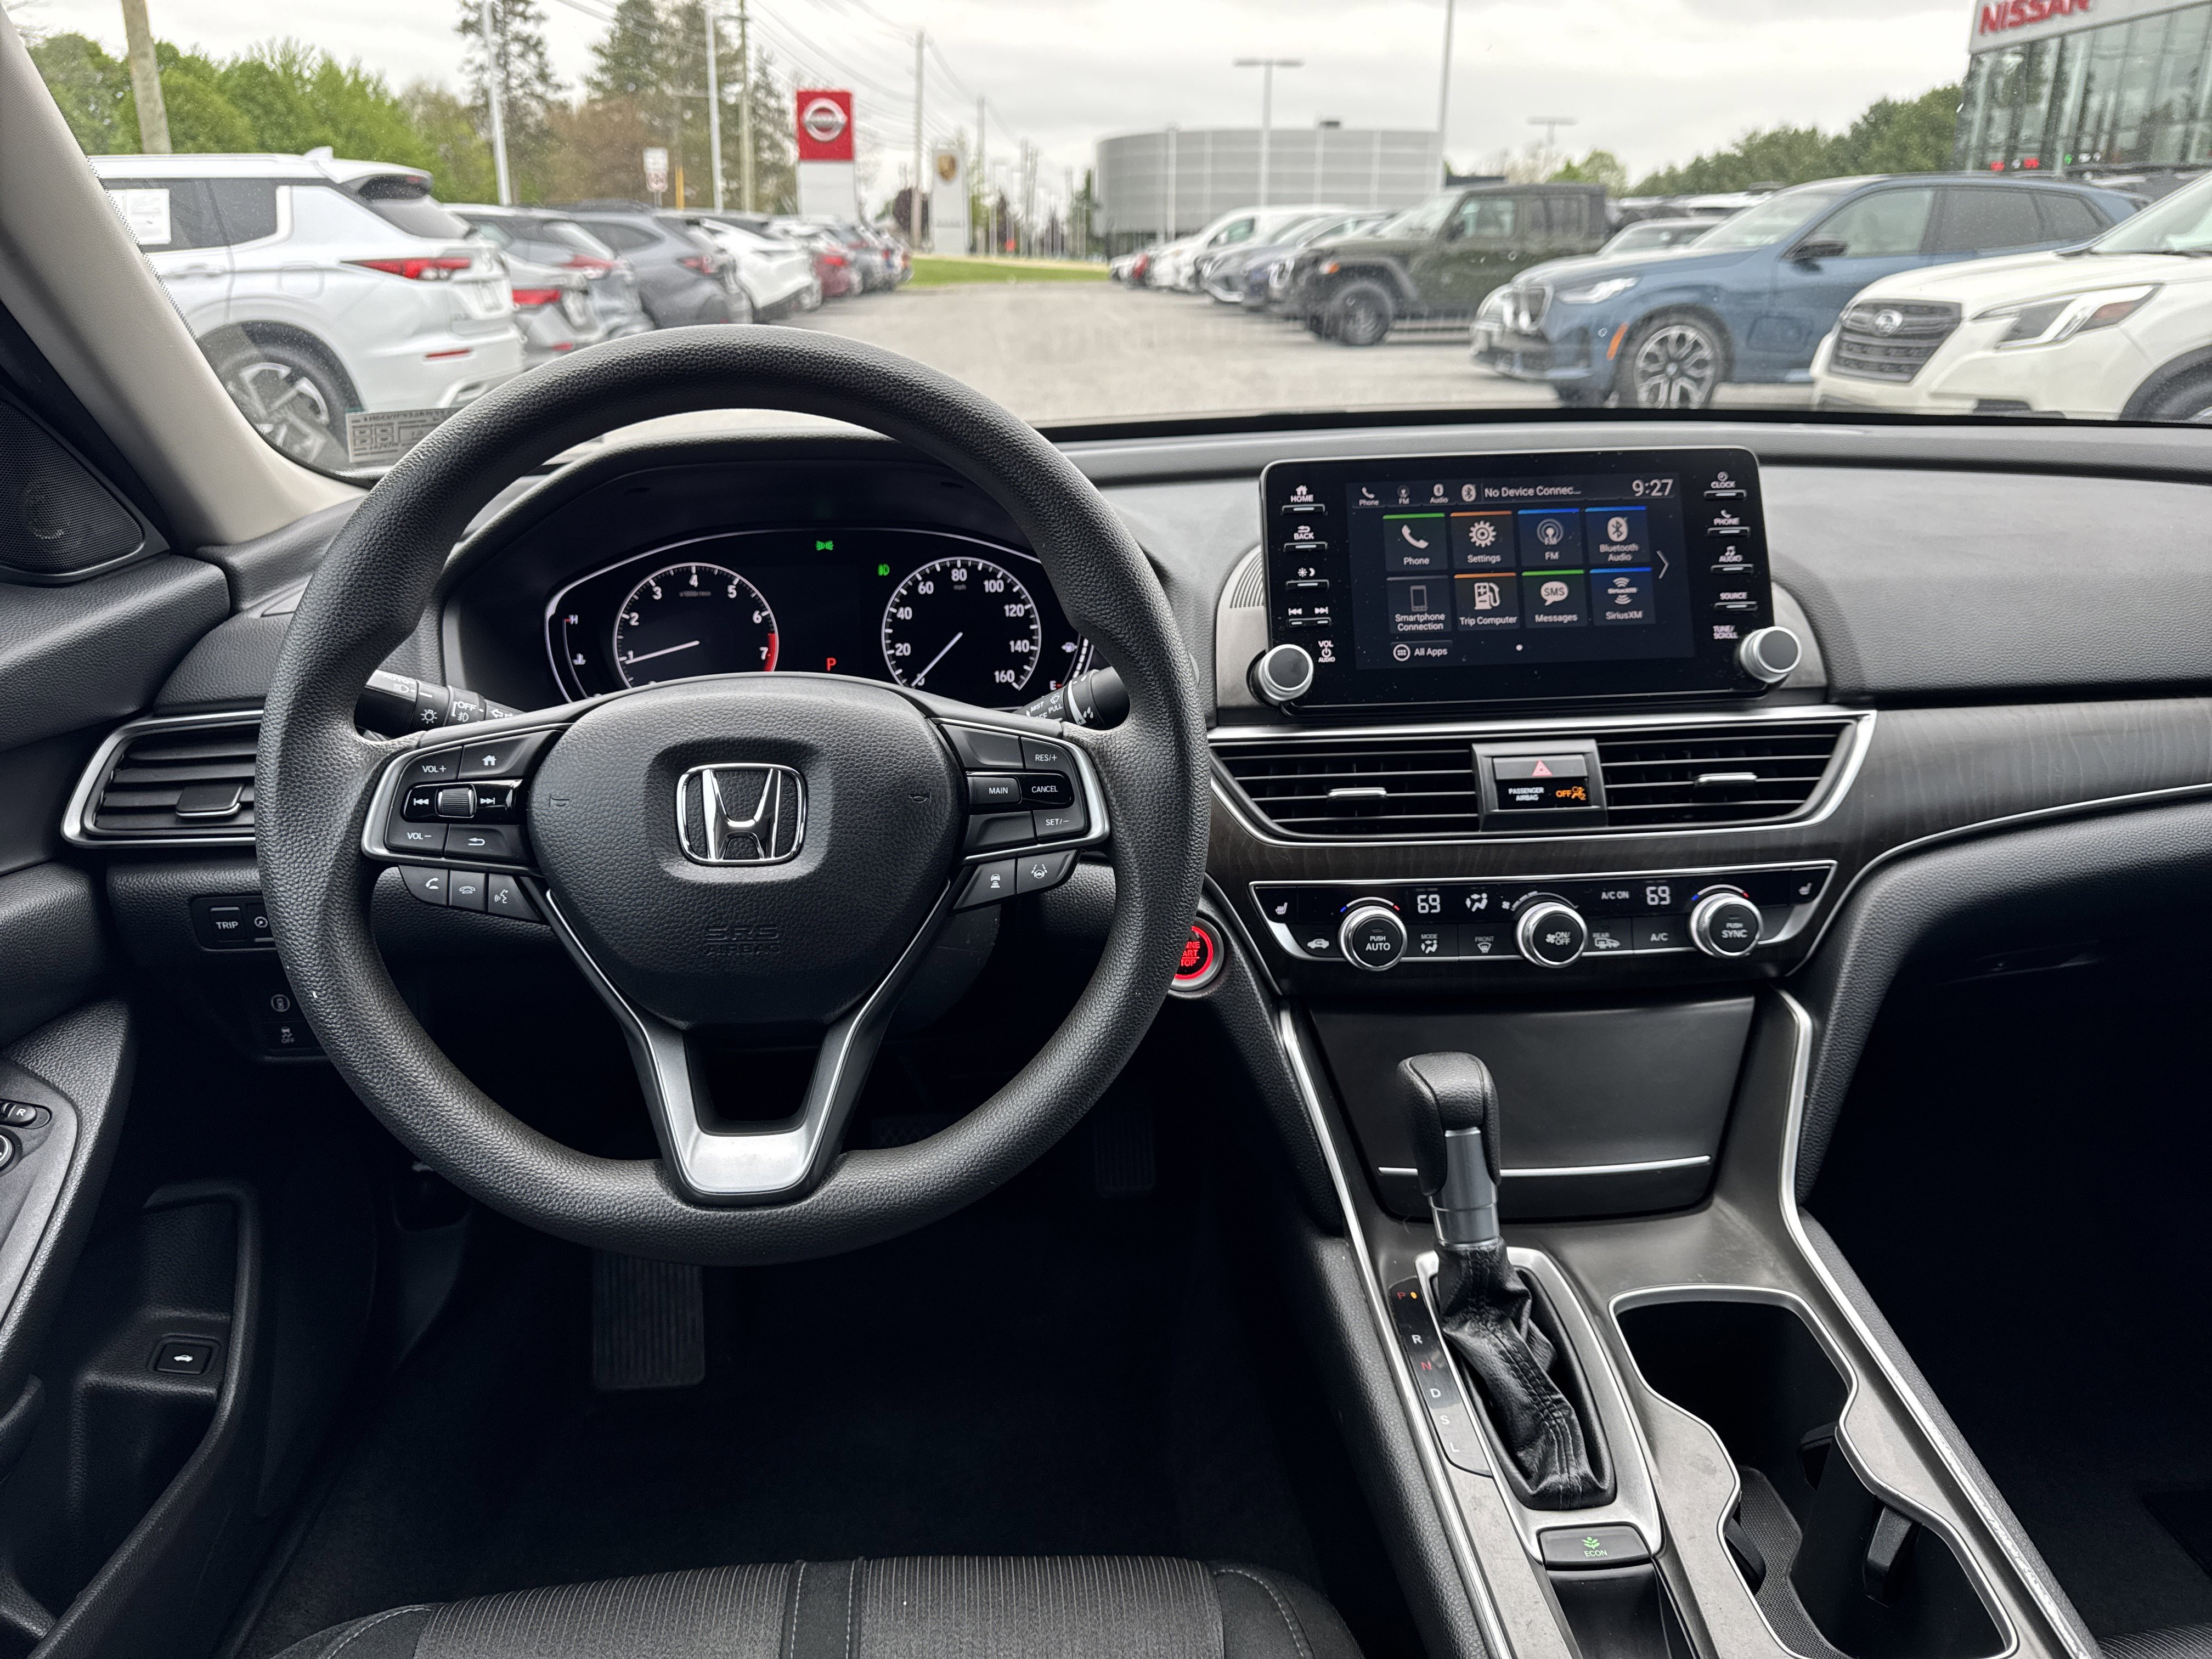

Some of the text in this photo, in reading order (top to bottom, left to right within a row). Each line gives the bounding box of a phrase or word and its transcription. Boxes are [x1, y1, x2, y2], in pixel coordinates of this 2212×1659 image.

[1632, 479, 1673, 496] 9:27
[1711, 481, 1735, 489] CLOCK
[1485, 485, 1581, 497] No Device Connec...
[1713, 517, 1739, 526] PHONE
[1600, 544, 1638, 552] Bluetooth
[1468, 555, 1501, 563] Settings
[1545, 551, 1559, 560] FM
[1607, 553, 1632, 562] Audio
[1719, 555, 1742, 563] AUDIO
[1403, 557, 1430, 566] Phone
[951, 568, 967, 582] 80
[689, 574, 698, 587] 4
[918, 581, 934, 594] 60
[983, 580, 1005, 592] 100
[652, 586, 662, 600] 3
[727, 585, 737, 599] 5
[1544, 587, 1565, 597] SMS
[897, 607, 912, 620] 40
[1004, 604, 1024, 617] 120
[569, 614, 578, 624] H
[630, 612, 639, 625] 2
[753, 610, 762, 624] 6
[1395, 613, 1445, 623] Smartphone
[1459, 616, 1517, 627] Trip Computer
[1536, 613, 1577, 623] Messages
[1397, 623, 1443, 631] Connection
[895, 643, 911, 656] 20
[1009, 640, 1030, 652] 140
[759, 647, 768, 660] 7
[1414, 647, 1448, 657] All Apps
[826, 658, 836, 671] P
[994, 670, 1014, 683] 160
[1049, 680, 1057, 690] E
[458, 701, 477, 711] OFF
[1031, 701, 1045, 712] MIST
[1048, 704, 1063, 713] PULL
[1601, 890, 1629, 900] A/C ON
[1646, 886, 1671, 905] 69
[1417, 894, 1441, 913] 69
[216, 921, 239, 929] TRIP
[1650, 933, 1668, 941] A/C
[1721, 929, 1747, 938] SYNC
[1365, 943, 1391, 951] AUTO
[16, 1108, 26, 1116] R
[1412, 1334, 1423, 1344] R
[1420, 1362, 1432, 1370] N
[1430, 1388, 1441, 1398] D
[1440, 1415, 1449, 1424] S
[1449, 1442, 1460, 1453] L
